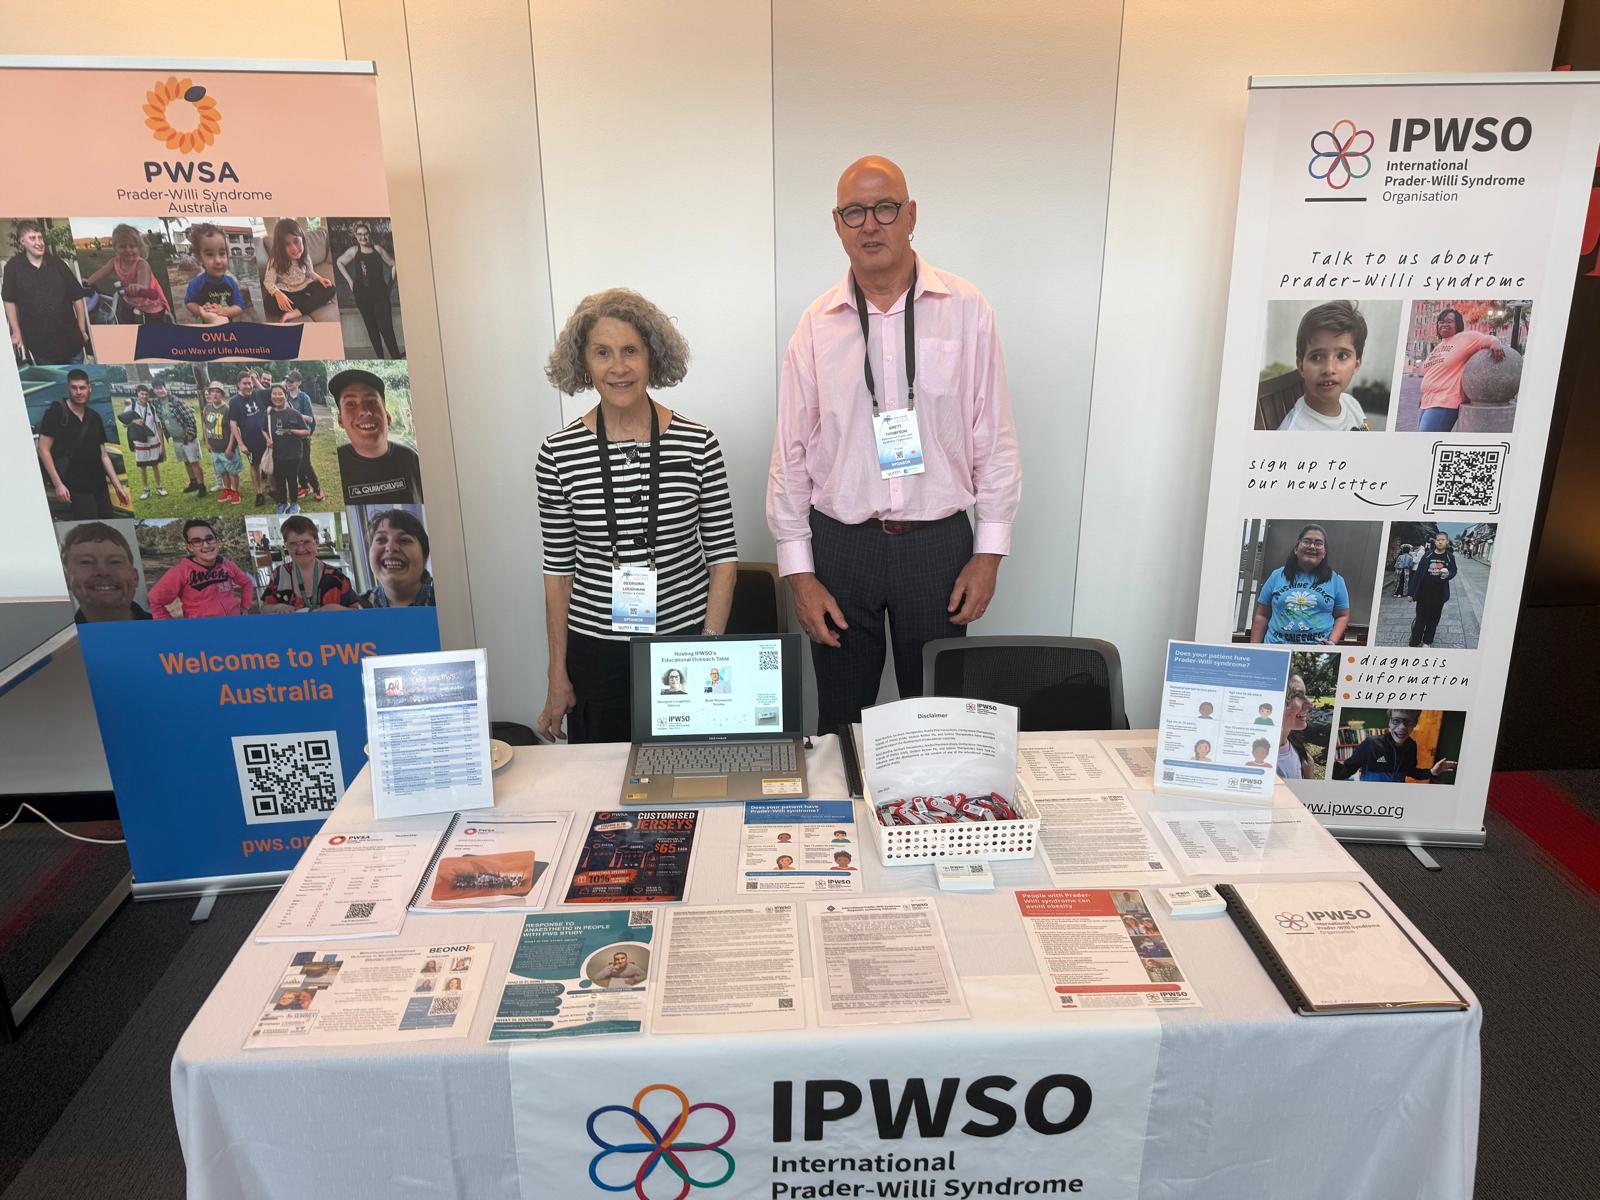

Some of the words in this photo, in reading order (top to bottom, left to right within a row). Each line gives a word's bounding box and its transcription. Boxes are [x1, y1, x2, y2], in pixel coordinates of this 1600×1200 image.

[1388, 116, 1533, 152] IPWSO
[143, 161, 240, 183] PWSA
[1386, 159, 1468, 171] International
[1384, 174, 1458, 187] Prader-Willi
[1461, 174, 1526, 188] Syndrome
[116, 188, 199, 201] Prader-Willi
[202, 188, 273, 204] Syndrome
[1382, 190, 1459, 205] Organisation
[168, 201, 228, 213] Australia
[1311, 250, 1354, 265] Talk
[1364, 251, 1387, 265] to
[1398, 253, 1419, 265] us
[1430, 250, 1494, 265] about
[1280, 272, 1414, 288] Prader-Willi
[1423, 273, 1527, 291] syndrome
[201, 332, 238, 342] OWLA
[171, 347, 187, 355] Our
[188, 347, 207, 355] Way
[207, 347, 216, 355] of
[217, 346, 232, 355] Life
[234, 346, 271, 354] Australia
[1248, 458, 1288, 474] sign
[1297, 459, 1318, 473] up
[1328, 459, 1347, 471] to
[1247, 477, 1279, 489] our
[1286, 476, 1388, 492] newsletter
[159, 648, 281, 675] Welcome
[286, 647, 314, 669] to
[319, 641, 378, 666] PWS
[1174, 657, 1213, 665] Prader-Willi
[1213, 660, 1250, 668] syndrome?
[1192, 651, 1208, 659] your
[1234, 654, 1251, 662] have
[1360, 654, 1448, 669] diagnosis
[1358, 672, 1470, 687] information
[219, 679, 335, 706] Australia
[1355, 690, 1428, 703] support
[977, 703, 997, 711] IPWSO
[1240, 777, 1263, 785] IPWSO
[637, 812, 695, 820] CUSTOMISED
[635, 820, 694, 830] JERSEYS
[241, 835, 313, 858] pws.or
[654, 843, 677, 854] $65
[1306, 909, 1371, 921] IPWSO
[772, 1073, 1093, 1142] IPWSO
[772, 1150, 956, 1173] International
[772, 1180, 937, 1200] Prader-Willi
[943, 1176, 1085, 1200] Syndrome
